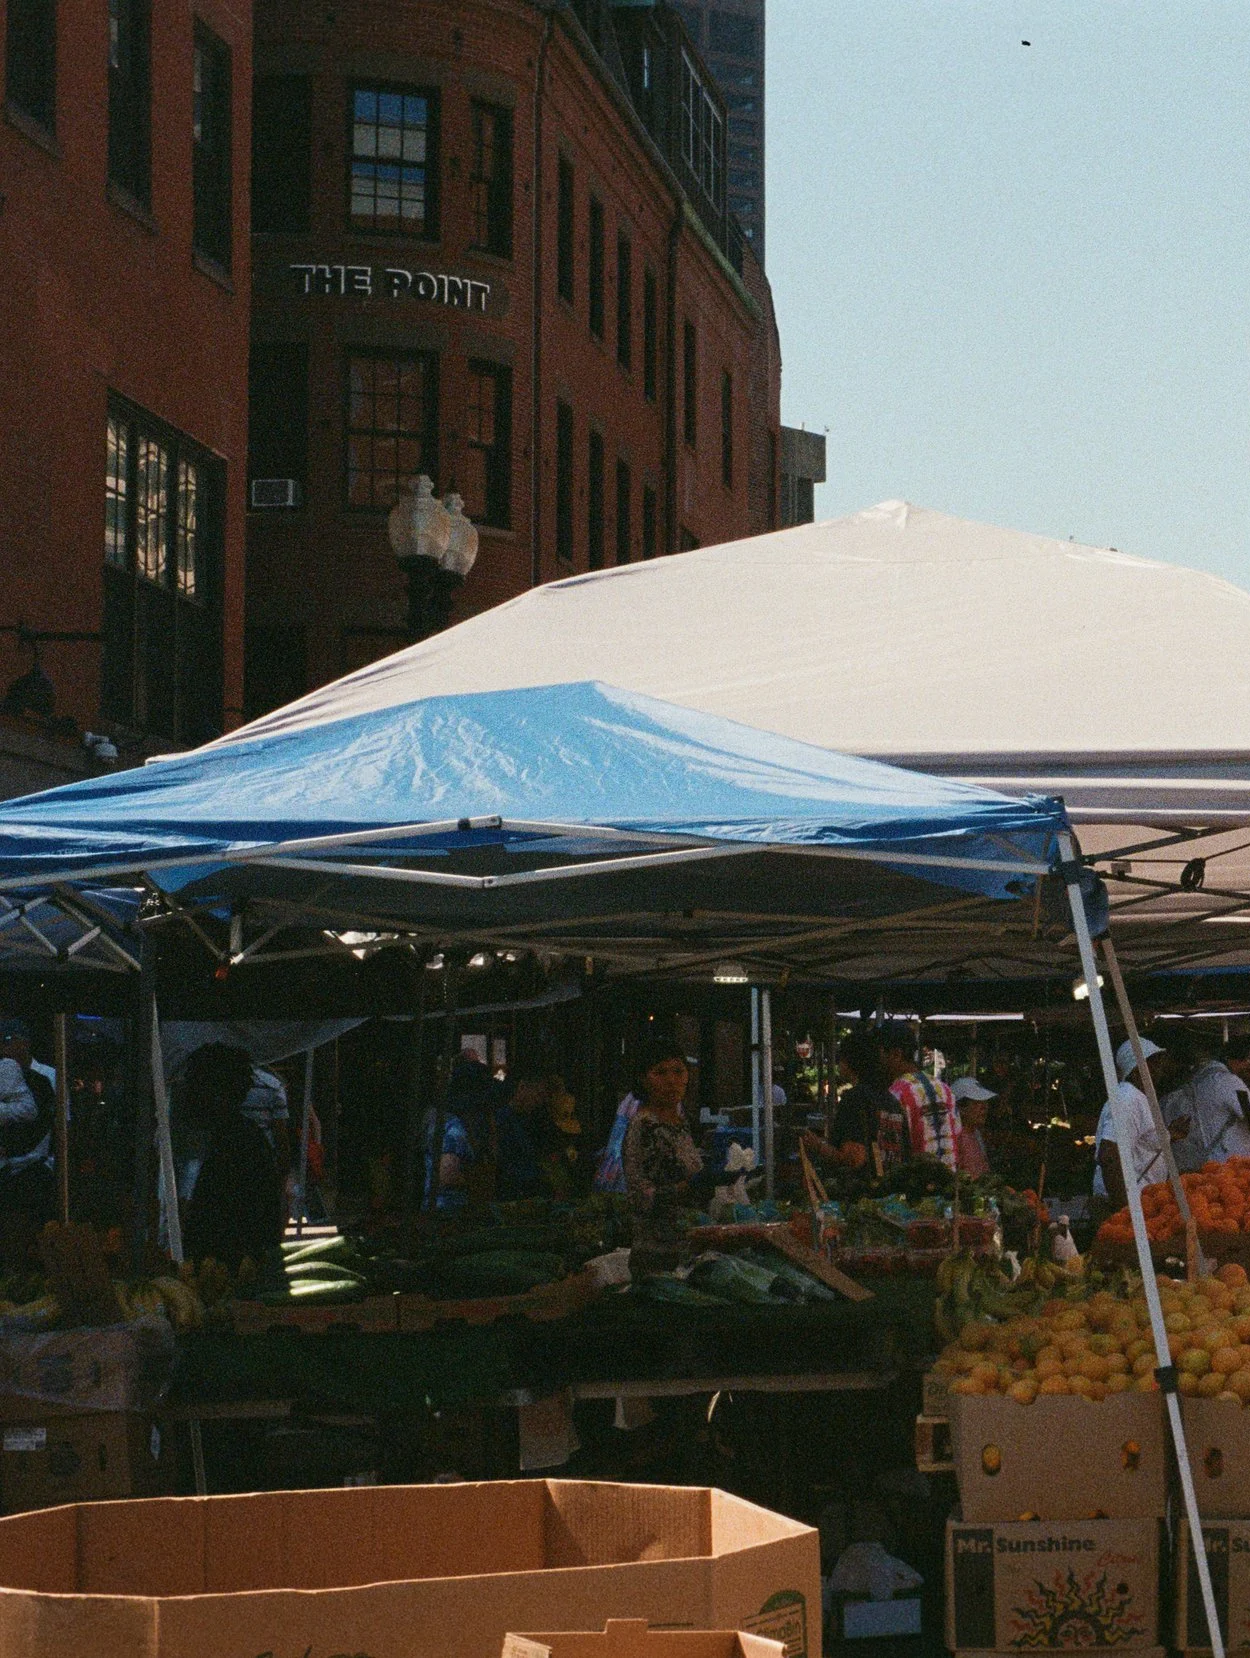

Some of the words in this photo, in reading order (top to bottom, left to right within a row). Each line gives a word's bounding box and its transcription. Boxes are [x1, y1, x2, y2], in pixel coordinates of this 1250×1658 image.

[289, 264, 372, 295] THE
[384, 268, 490, 312] POINT
[956, 1538, 992, 1554] Mr.
[996, 1536, 1097, 1554] Sunshine
